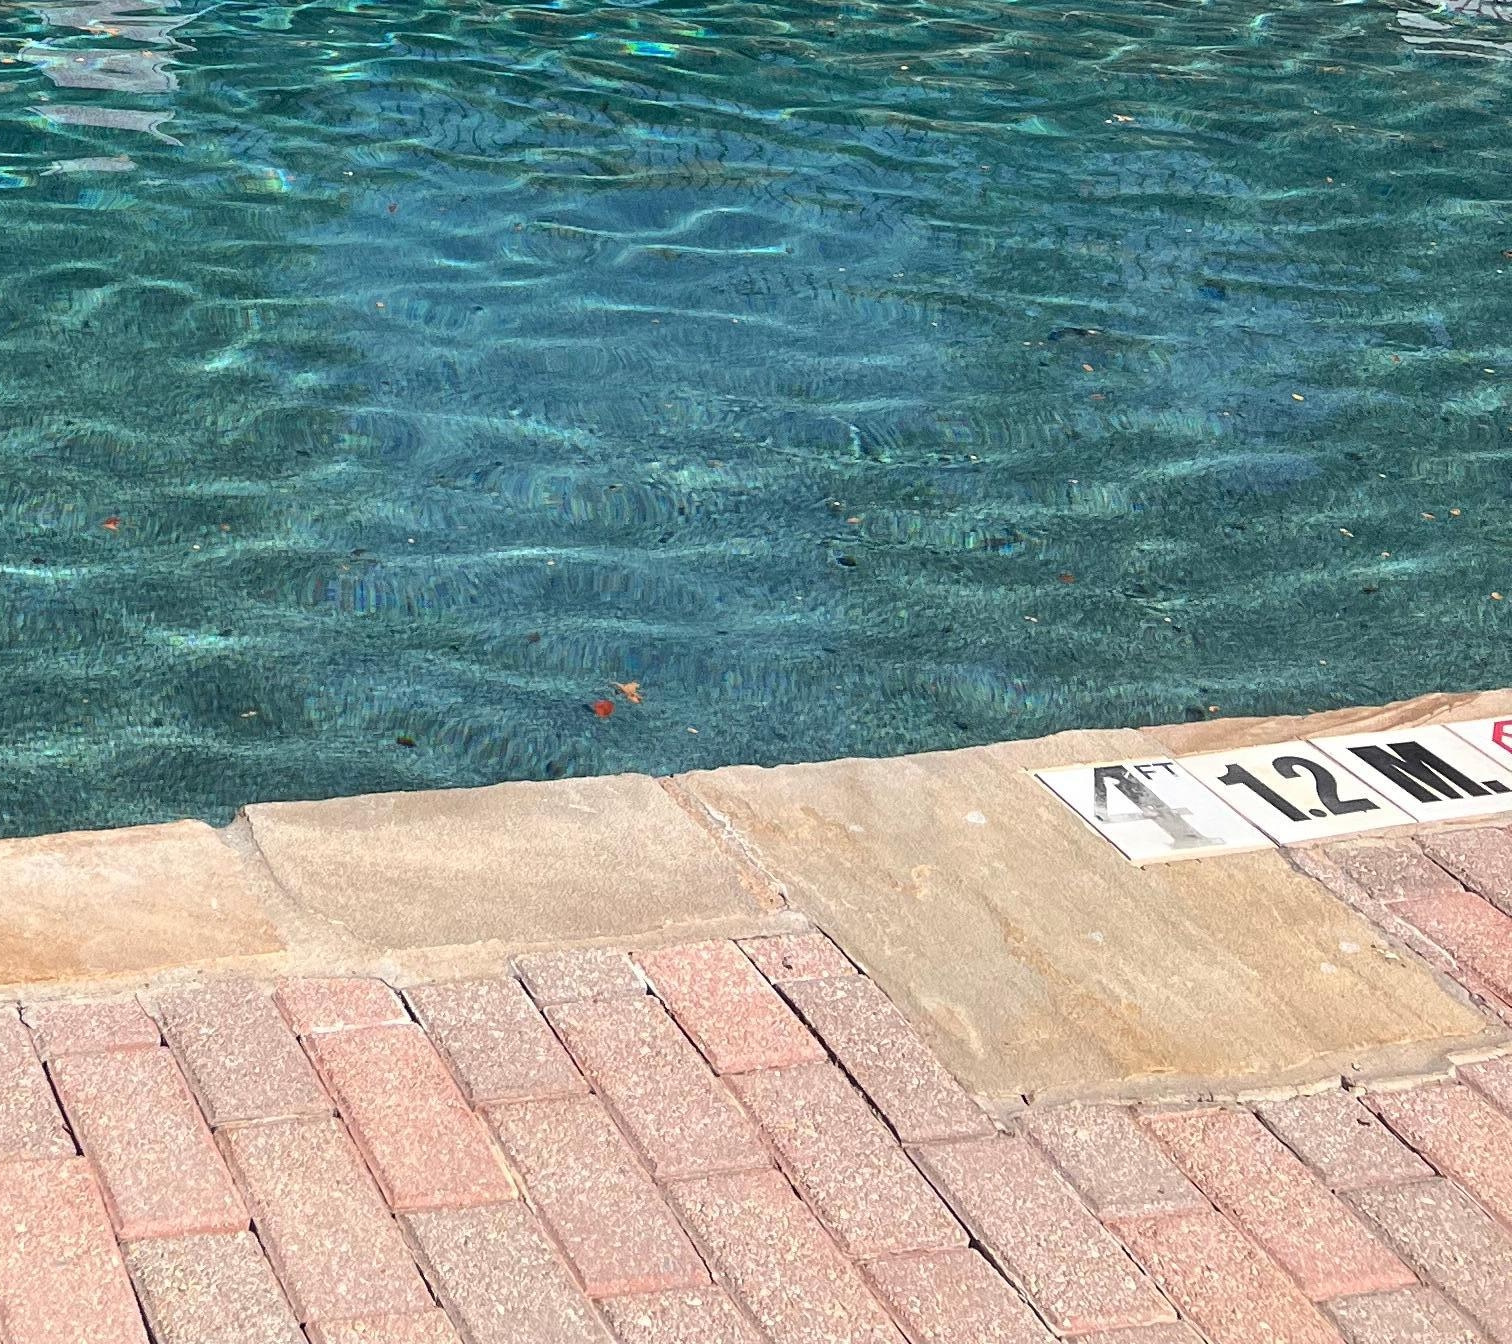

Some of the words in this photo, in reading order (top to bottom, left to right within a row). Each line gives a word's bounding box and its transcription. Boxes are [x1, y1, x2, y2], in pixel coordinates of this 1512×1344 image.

[1134, 761, 1179, 781] FT
[1217, 755, 1380, 822] 1.2
[1347, 741, 1511, 803] M.
